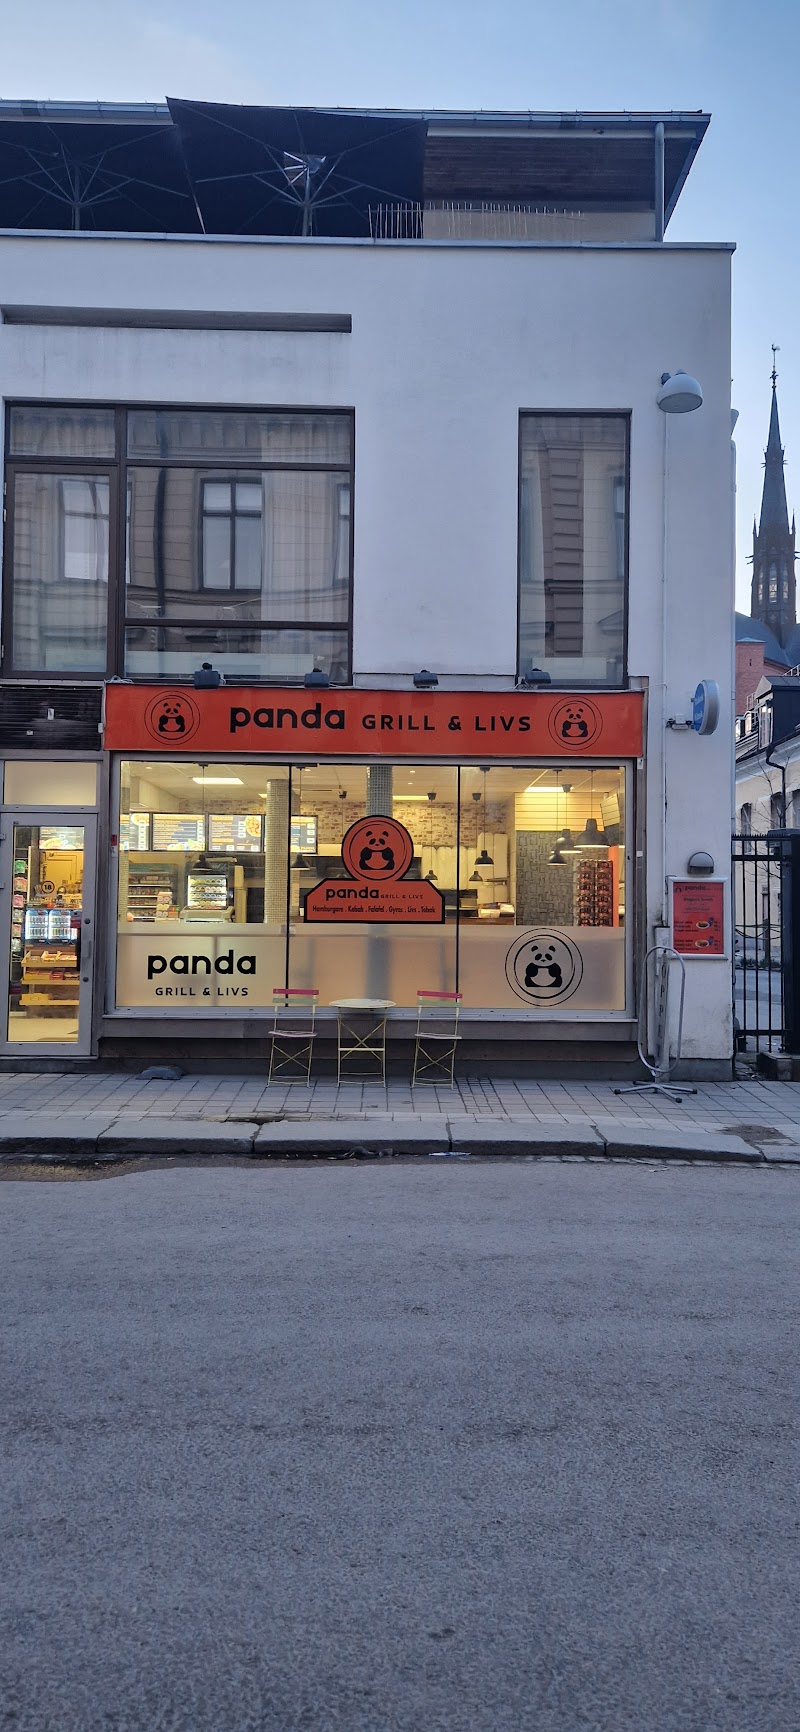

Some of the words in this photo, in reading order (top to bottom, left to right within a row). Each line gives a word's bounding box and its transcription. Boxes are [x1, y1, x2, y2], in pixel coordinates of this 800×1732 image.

[230, 702, 345, 733] panda
[361, 714, 436, 731] GRILL
[448, 715, 462, 731] &
[475, 715, 531, 732] LIVS
[325, 886, 379, 901] panda
[388, 905, 404, 914] Gyros
[147, 949, 256, 980] panda
[155, 987, 196, 996] GRILL
[202, 987, 211, 996] &
[217, 987, 249, 996] LIVS
